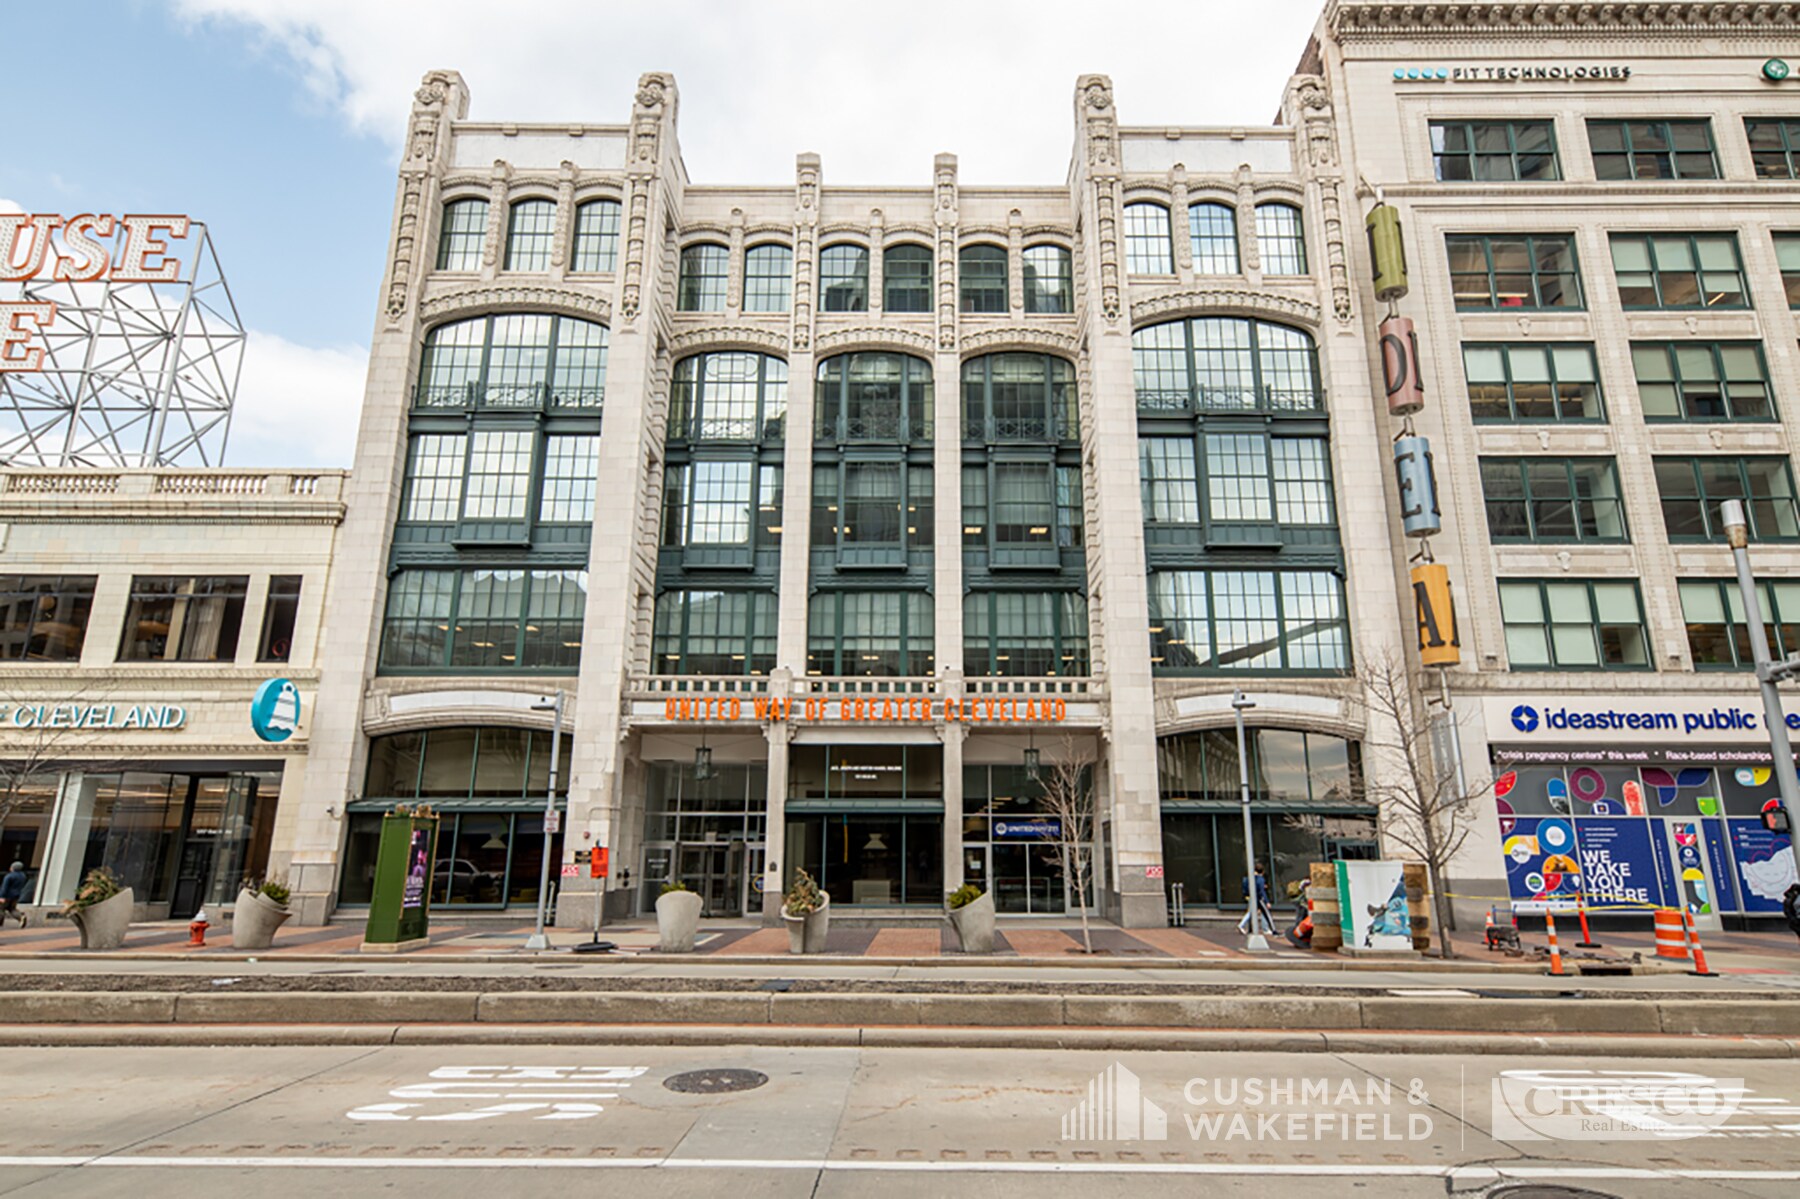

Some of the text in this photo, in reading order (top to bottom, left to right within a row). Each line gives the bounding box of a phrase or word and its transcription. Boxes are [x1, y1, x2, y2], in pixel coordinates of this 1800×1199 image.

[1452, 66, 1632, 79] FIT TECHNOLOGIES
[13, 704, 187, 729] CLEVELAND
[665, 697, 1067, 722] UNITED WAY OF GREATER CLEVELAND
[1544, 708, 1678, 730] ideastream
[1683, 708, 1758, 734] public
[1526, 752, 1569, 761] pregnancy
[1608, 751, 1625, 760] this
[1626, 751, 1649, 760] week
[1719, 751, 1772, 761] scholarships
[1582, 850, 1611, 863] WE
[1584, 862, 1631, 876] TAKE
[1586, 875, 1624, 889] YOU
[1588, 888, 1649, 902] THERE
